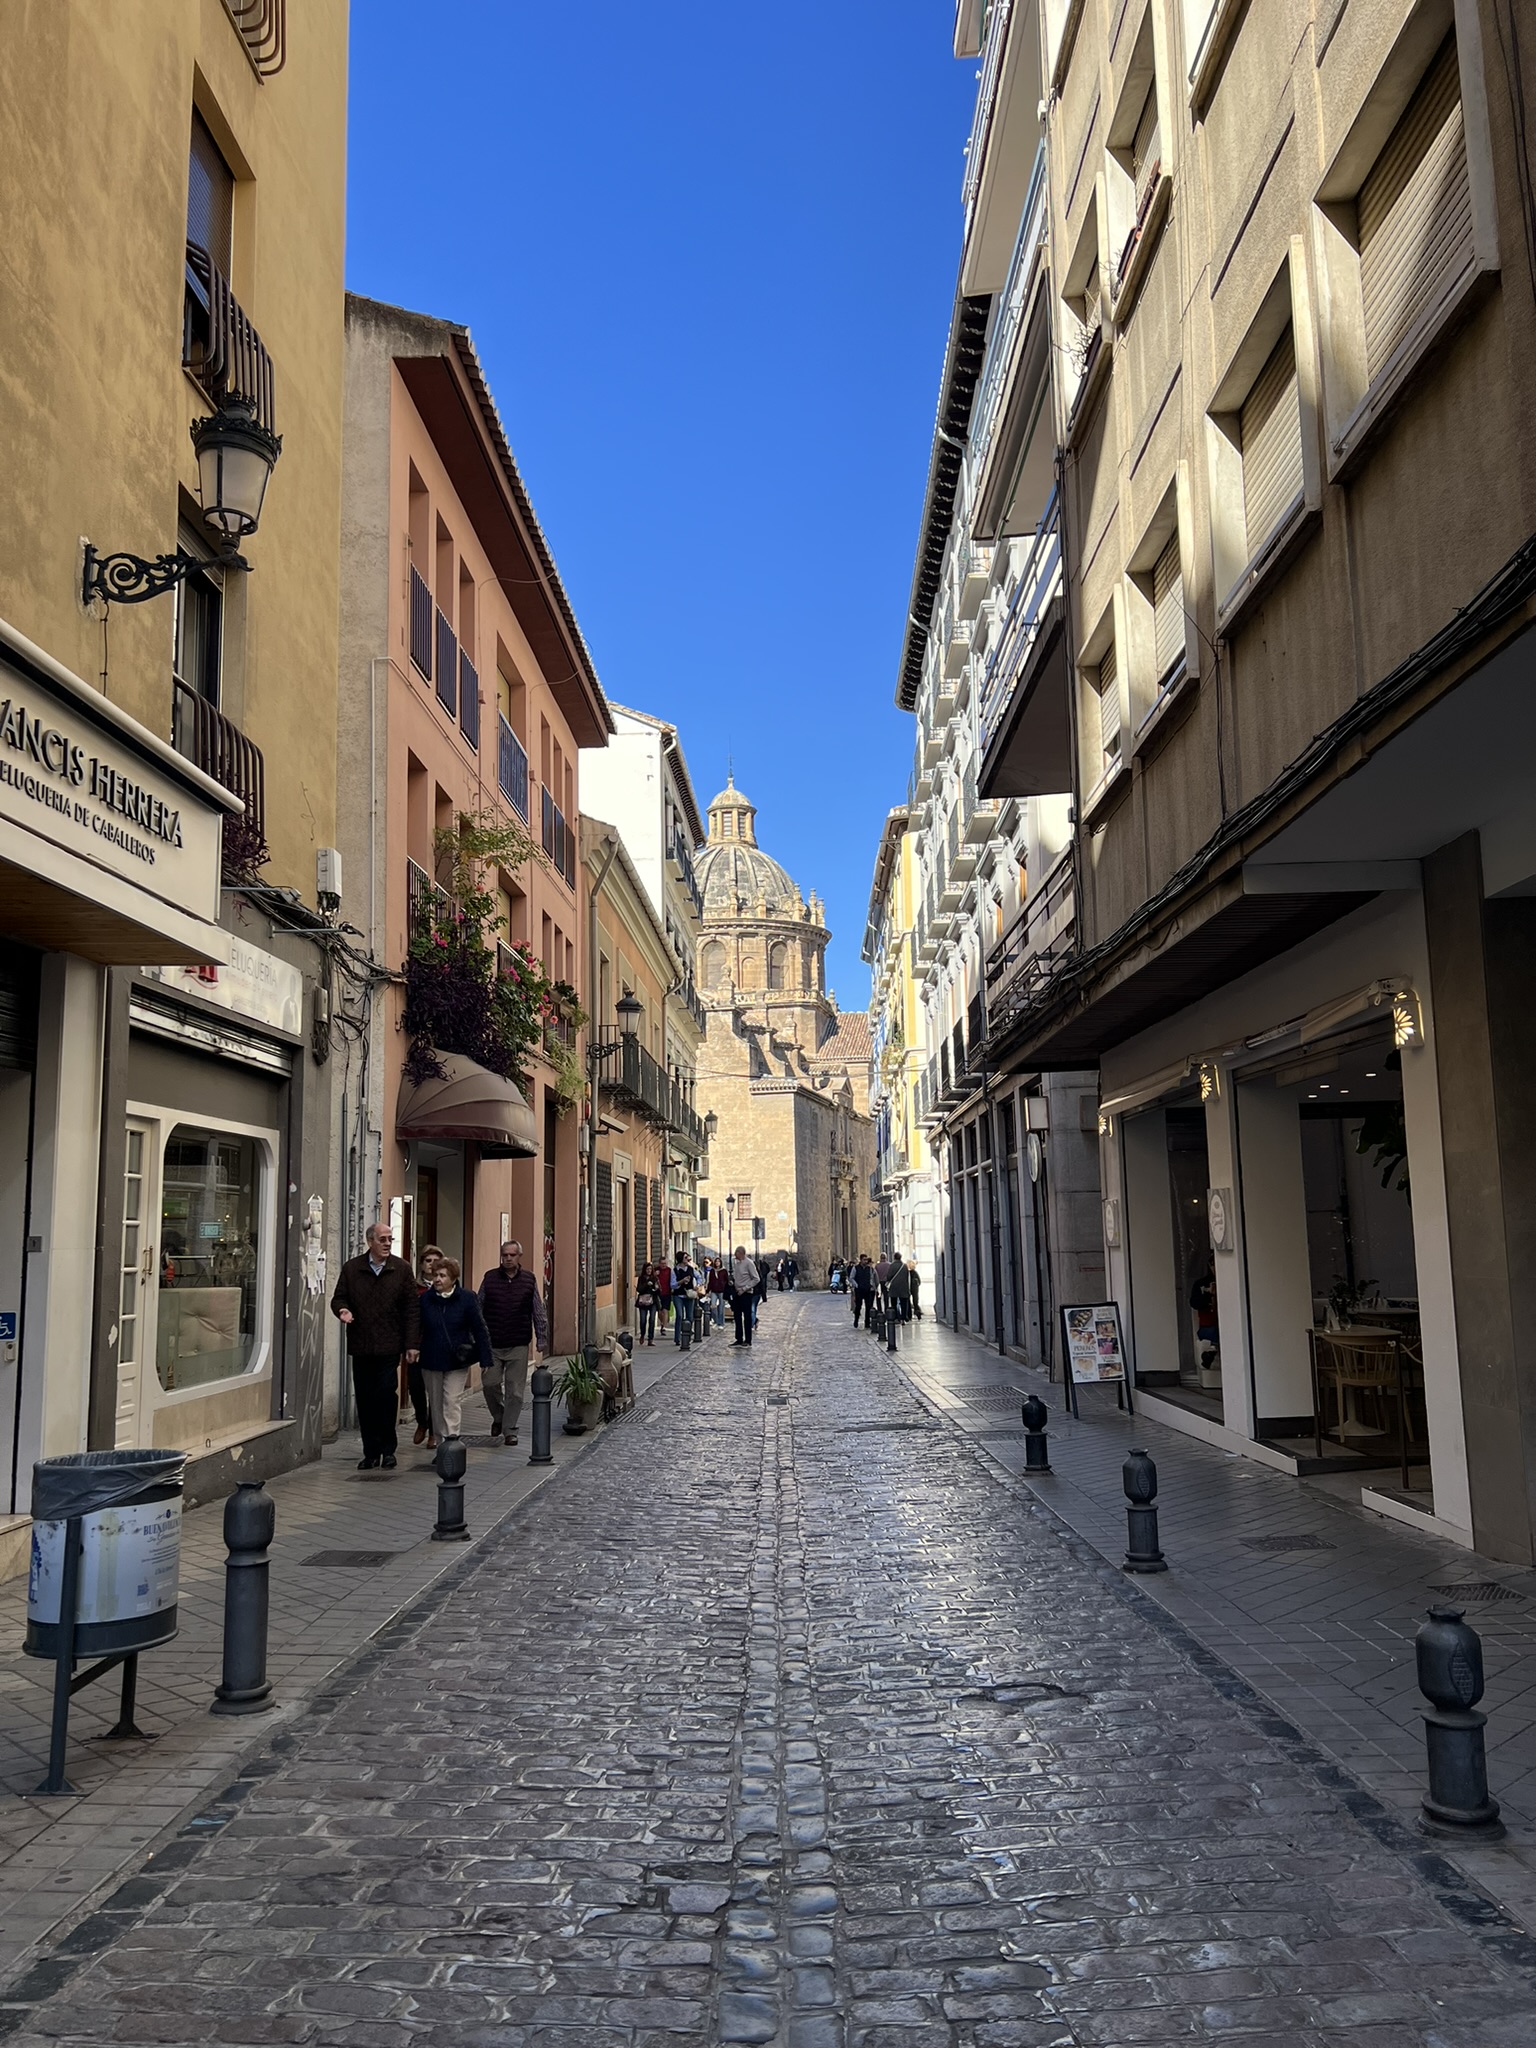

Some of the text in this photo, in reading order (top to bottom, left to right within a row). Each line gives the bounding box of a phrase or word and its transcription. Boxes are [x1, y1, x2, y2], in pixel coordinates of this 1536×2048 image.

[74, 803, 90, 827] DE
[92, 814, 156, 865] CABALLEROS
[90, 758, 184, 848] HERRERA
